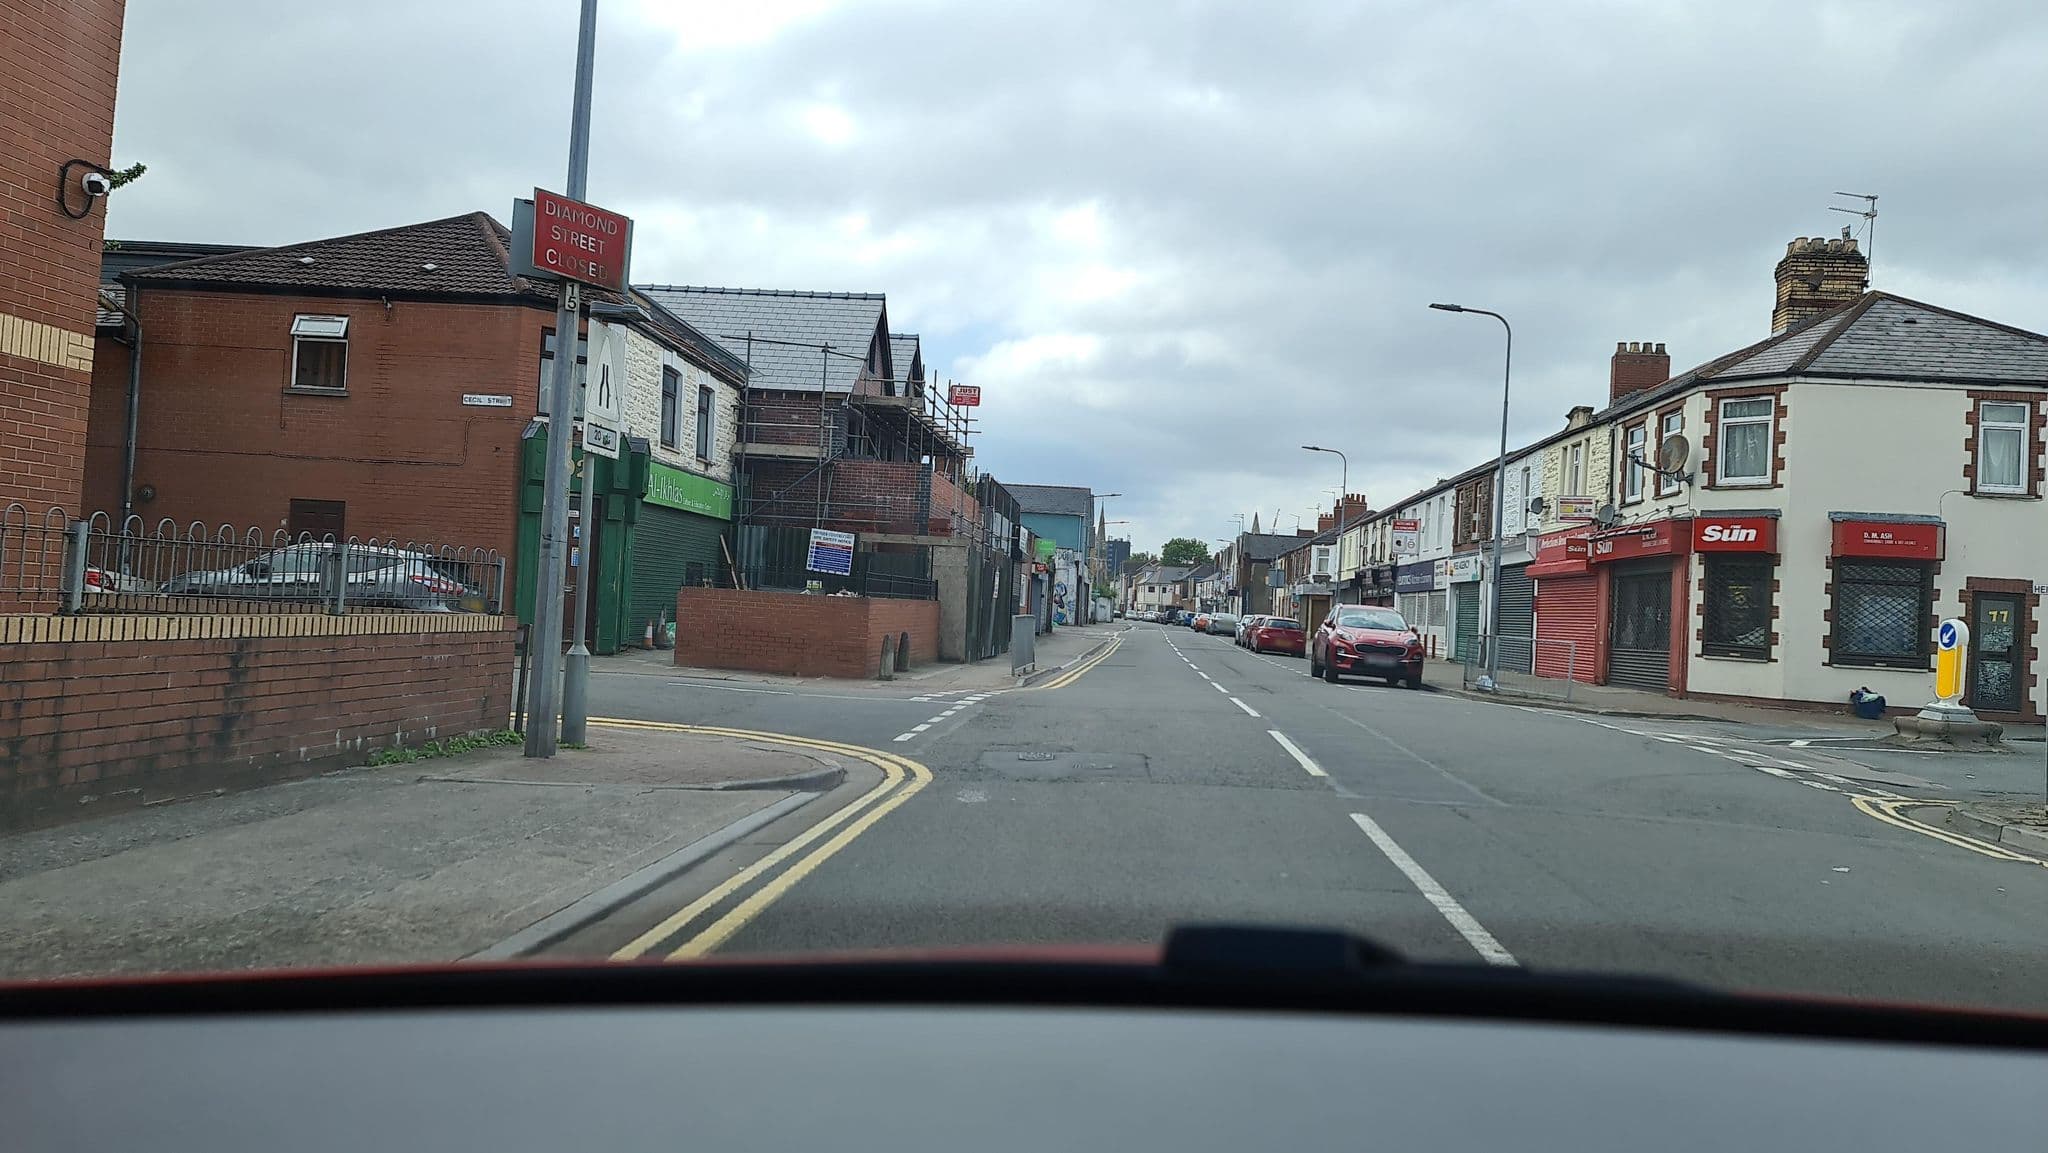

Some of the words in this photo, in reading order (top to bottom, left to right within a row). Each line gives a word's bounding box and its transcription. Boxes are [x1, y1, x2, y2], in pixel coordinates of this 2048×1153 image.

[545, 200, 618, 235] DIAMOND
[551, 225, 605, 255] STREET
[546, 249, 608, 280] CLOSED
[648, 474, 683, 504] Al-Ikhlas
[1701, 524, 1757, 542] Sun
[1880, 532, 1893, 540] ASH
[1567, 545, 1586, 553] Sun
[1596, 540, 1613, 555] Sun
[2034, 585, 2048, 594] HE
[1988, 610, 2009, 623] 77
